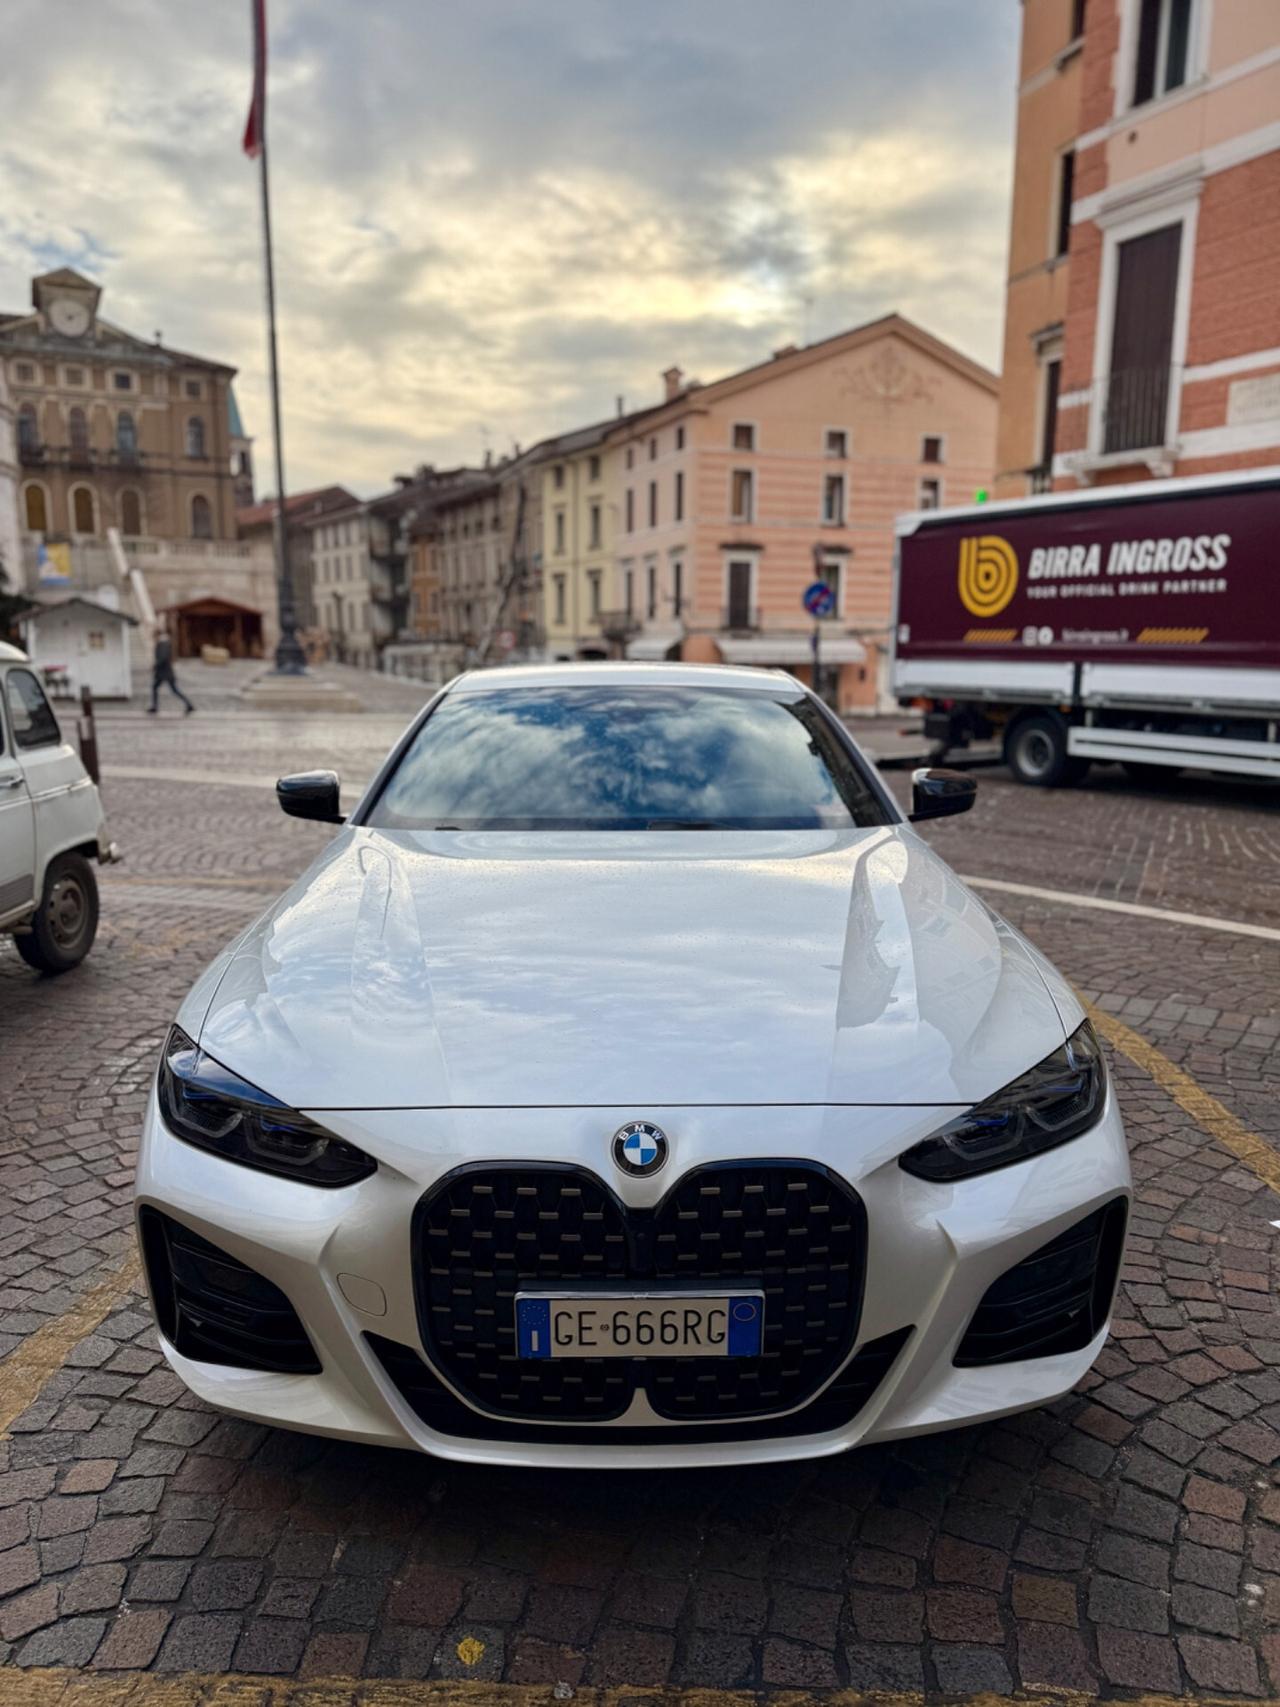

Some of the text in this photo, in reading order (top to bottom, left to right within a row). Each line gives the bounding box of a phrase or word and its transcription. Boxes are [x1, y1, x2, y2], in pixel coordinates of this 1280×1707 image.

[1027, 534, 1231, 580] BIRRA INGROSS
[1026, 578, 1228, 599] YOUR OFFICIAL DRINK PARTNER
[618, 1124, 663, 1140] BMW
